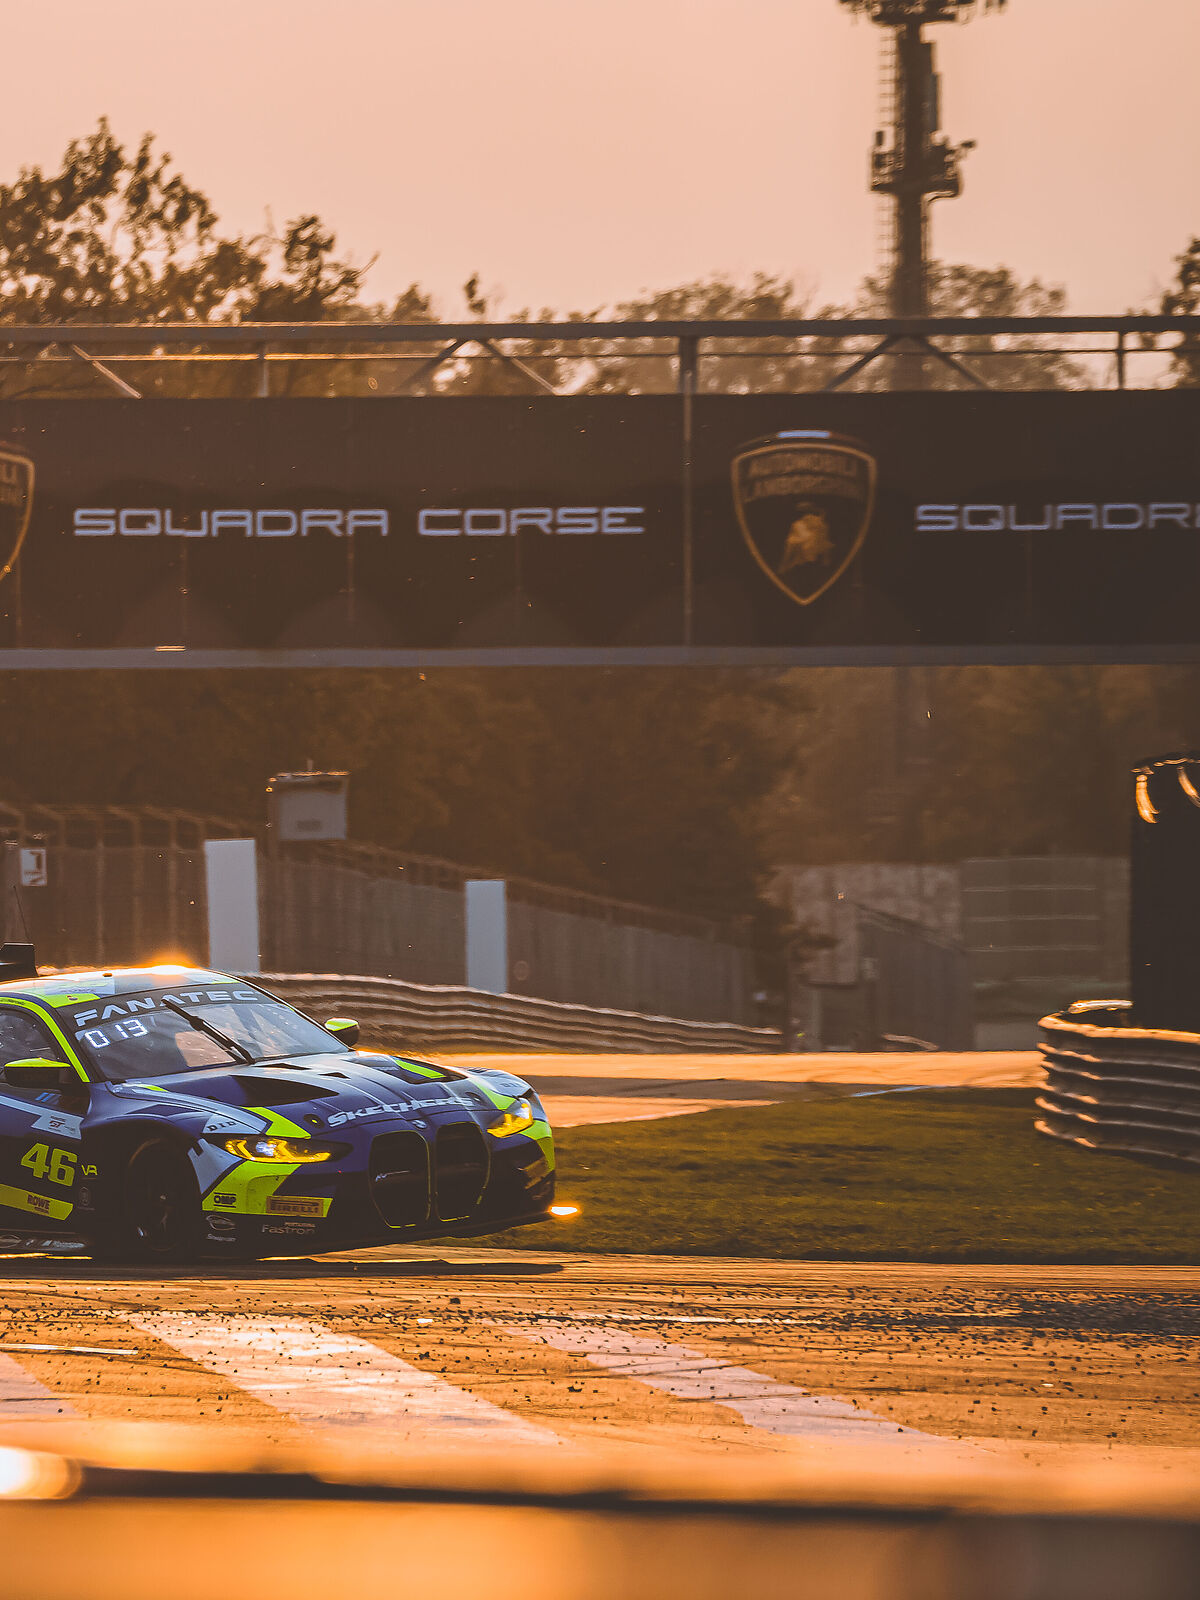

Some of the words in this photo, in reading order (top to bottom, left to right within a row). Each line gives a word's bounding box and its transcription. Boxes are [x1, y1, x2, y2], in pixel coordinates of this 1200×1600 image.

[73, 507, 389, 537] SQUADRA
[418, 506, 644, 535] CORSE
[915, 503, 1200, 530] SQUADR
[73, 990, 259, 1027] FANATEC
[327, 1097, 475, 1128] SKECHERS
[20, 1142, 78, 1187] 46
[270, 1199, 319, 1214] PIRELLI
